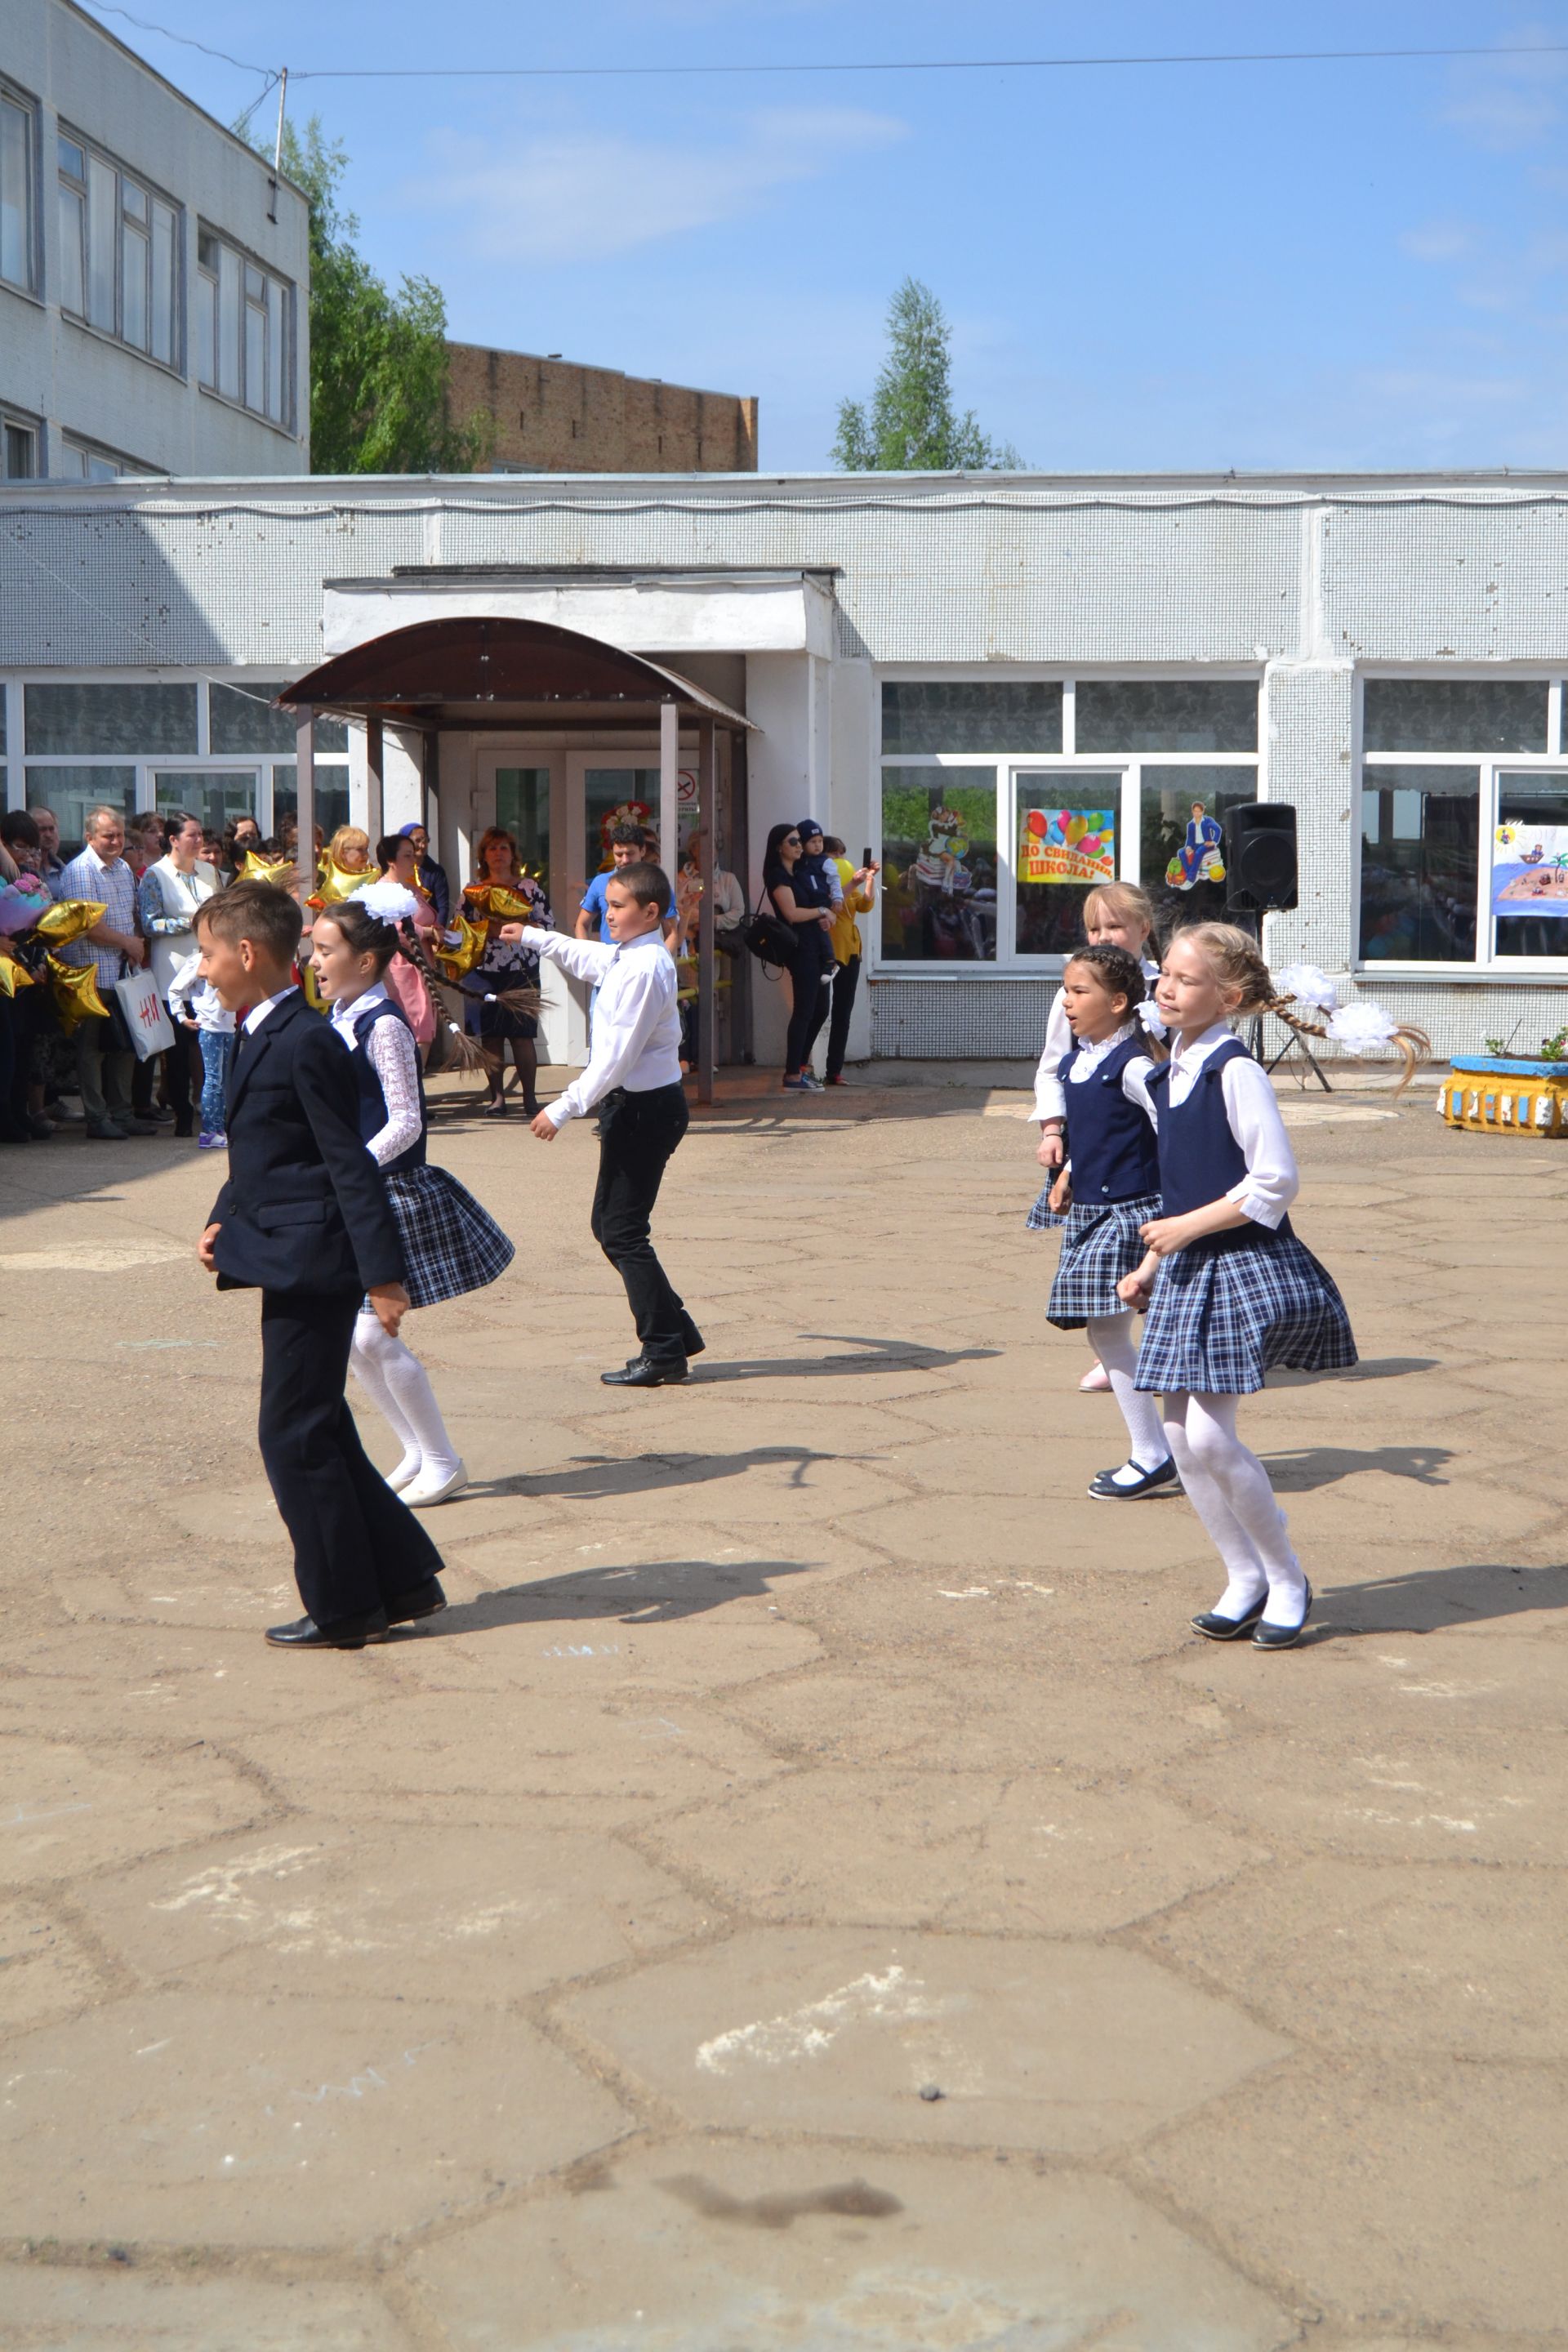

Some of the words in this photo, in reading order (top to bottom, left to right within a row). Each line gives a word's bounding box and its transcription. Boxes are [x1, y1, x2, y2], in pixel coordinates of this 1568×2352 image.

[1021, 844, 1040, 858] ДО
[1045, 846, 1113, 879] СВИДАНИЯ,
[1029, 860, 1094, 880] ШКОЛА!
